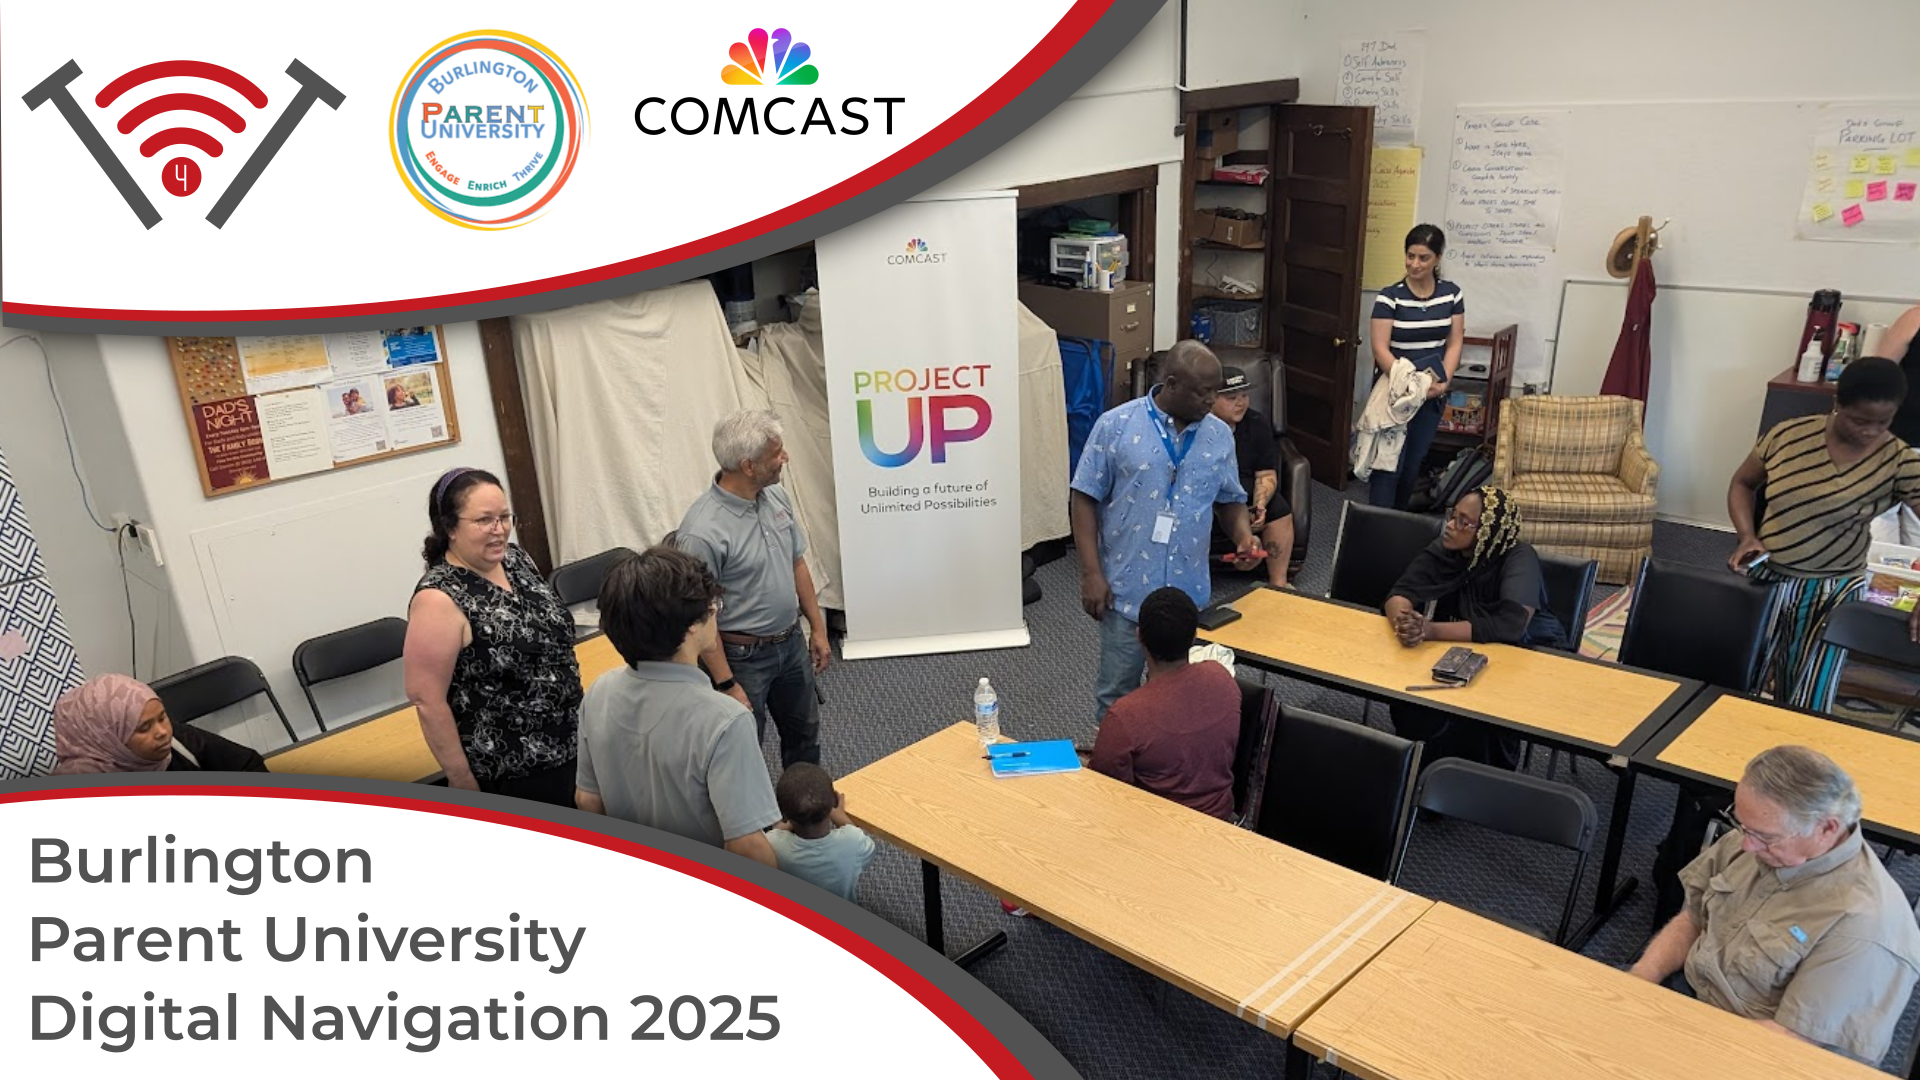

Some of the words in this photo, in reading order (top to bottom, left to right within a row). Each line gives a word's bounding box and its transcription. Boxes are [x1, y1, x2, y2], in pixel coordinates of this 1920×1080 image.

[1351, 54, 1370, 69] Self
[1381, 87, 1399, 97] Skills
[1838, 128, 1885, 144] PARKING
[1890, 131, 1916, 143] LOT
[887, 253, 948, 265] COMCAST
[854, 364, 992, 394] PROJECT
[202, 399, 250, 418] DAD'S
[206, 410, 253, 430] NIGHT
[856, 394, 993, 468] UP
[868, 486, 920, 498] Building
[922, 486, 931, 495] a
[934, 482, 973, 494] future
[975, 479, 989, 491] of
[861, 501, 921, 514] Unlimited
[924, 497, 998, 510] Possibilities
